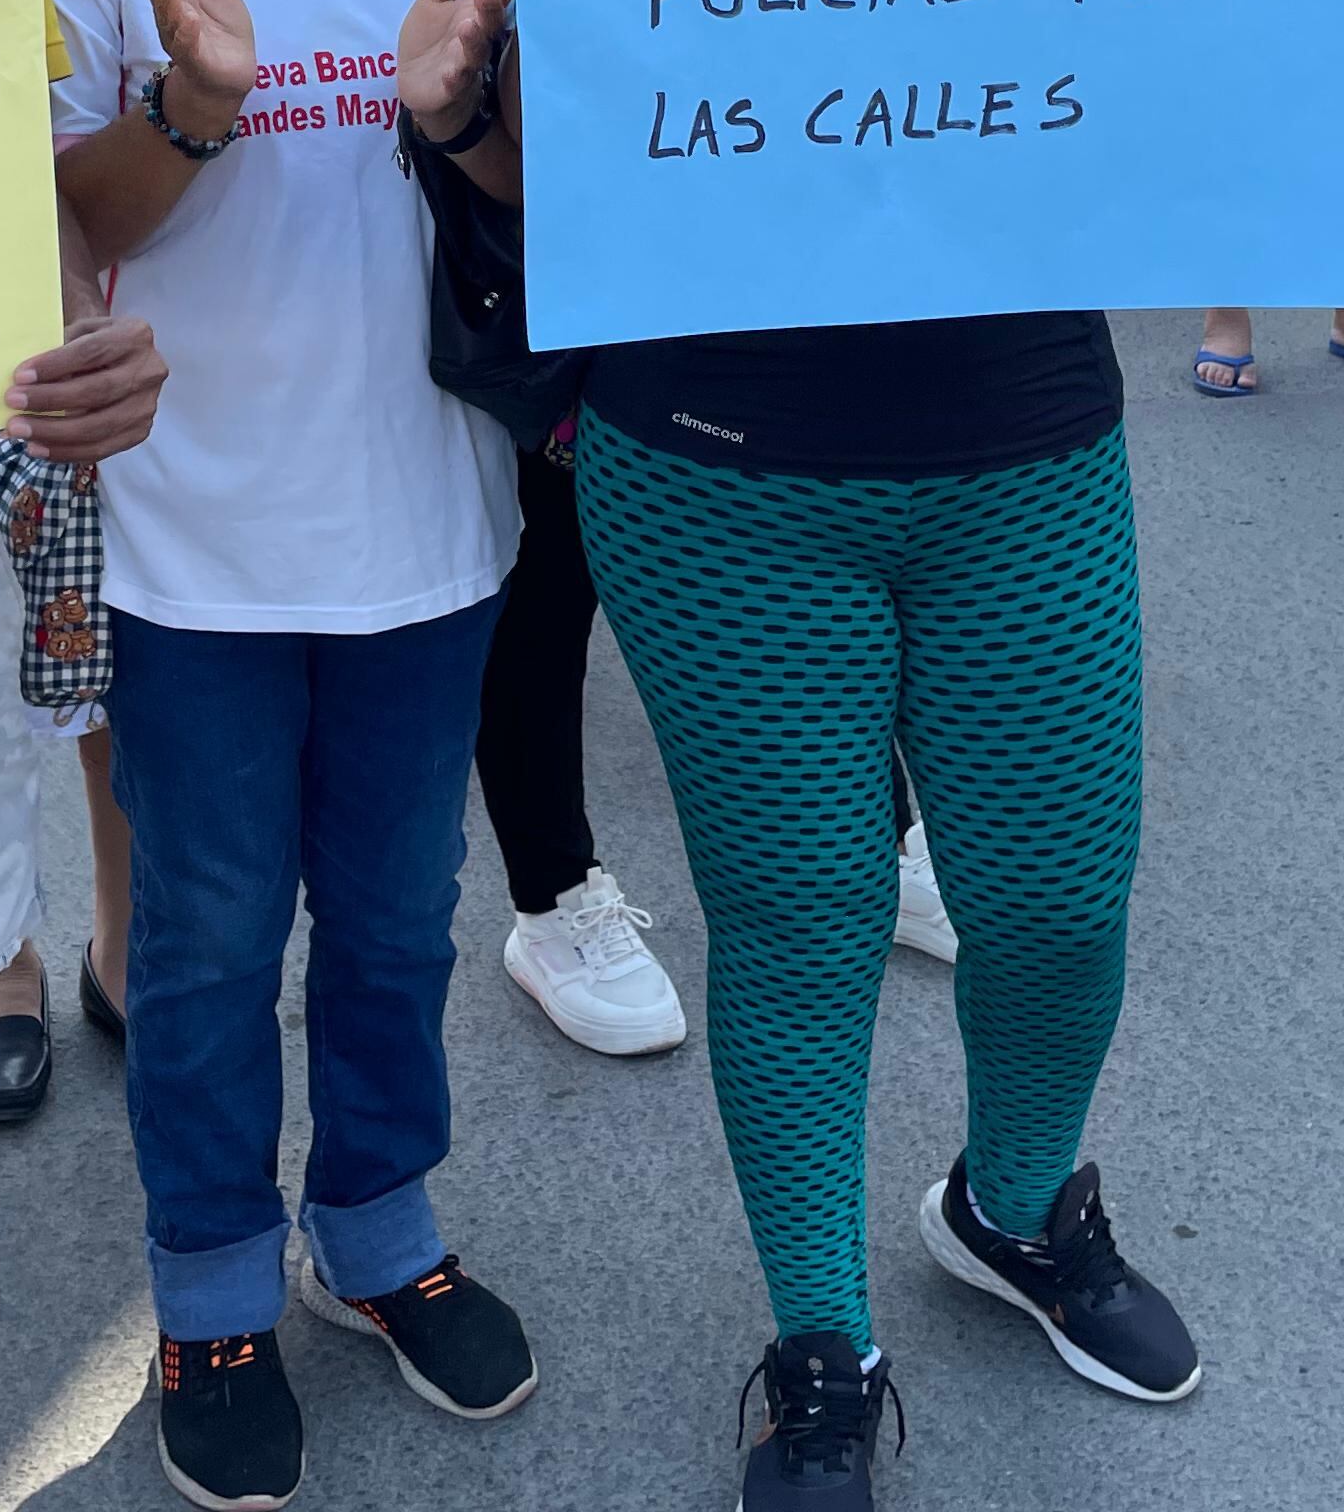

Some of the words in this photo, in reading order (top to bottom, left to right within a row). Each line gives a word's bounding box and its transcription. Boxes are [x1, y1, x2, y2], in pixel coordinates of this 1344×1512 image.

[255, 60, 307, 90] eva
[314, 50, 398, 83] Banc
[236, 101, 326, 139] andes
[335, 92, 399, 131] May
[649, 92, 765, 158] LAS
[806, 75, 1082, 145] CALLES
[671, 412, 744, 444] climacool
